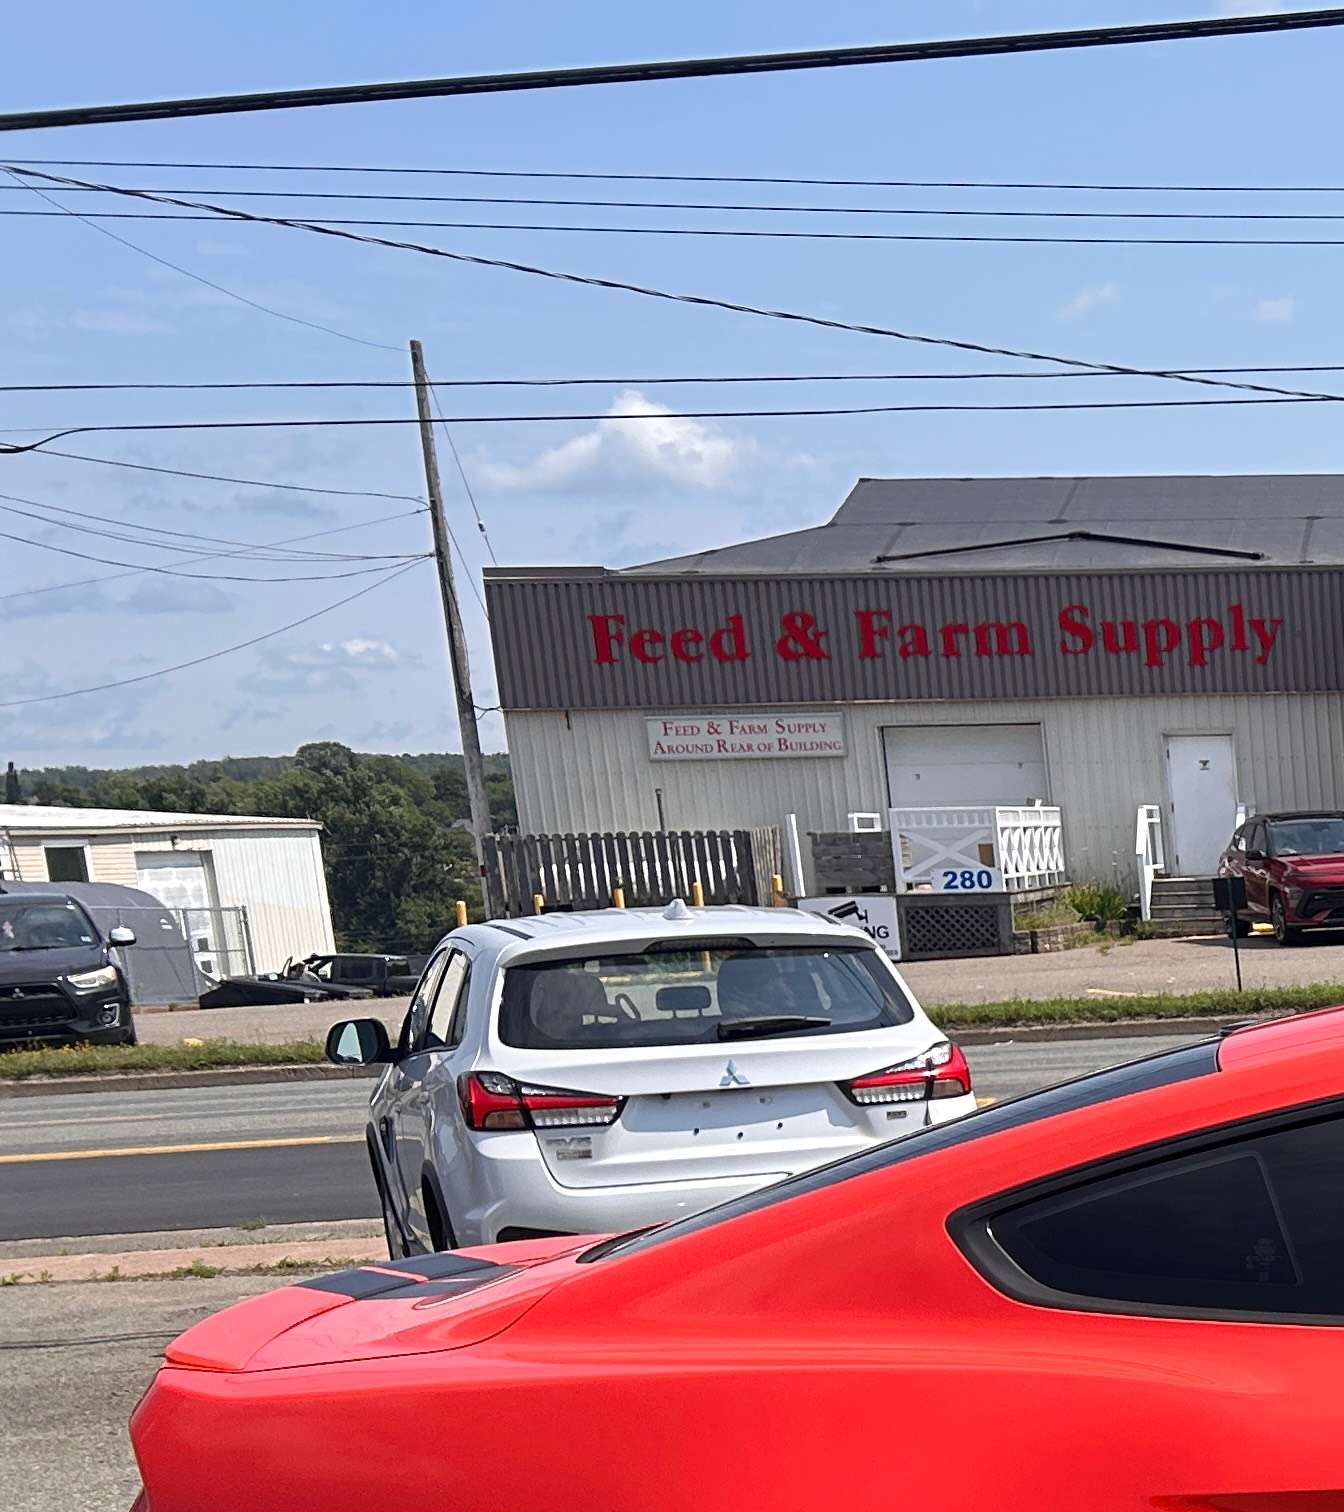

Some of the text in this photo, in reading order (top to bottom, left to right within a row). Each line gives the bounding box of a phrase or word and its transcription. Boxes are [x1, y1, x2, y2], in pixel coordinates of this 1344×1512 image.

[587, 603, 1284, 669] Feed & Farm Supply
[662, 719, 827, 737] FEED & FARM SUPPLY
[654, 740, 714, 755] AROUND
[716, 739, 754, 753] REAR
[777, 737, 842, 752] BUILDING
[942, 870, 993, 890] 280
